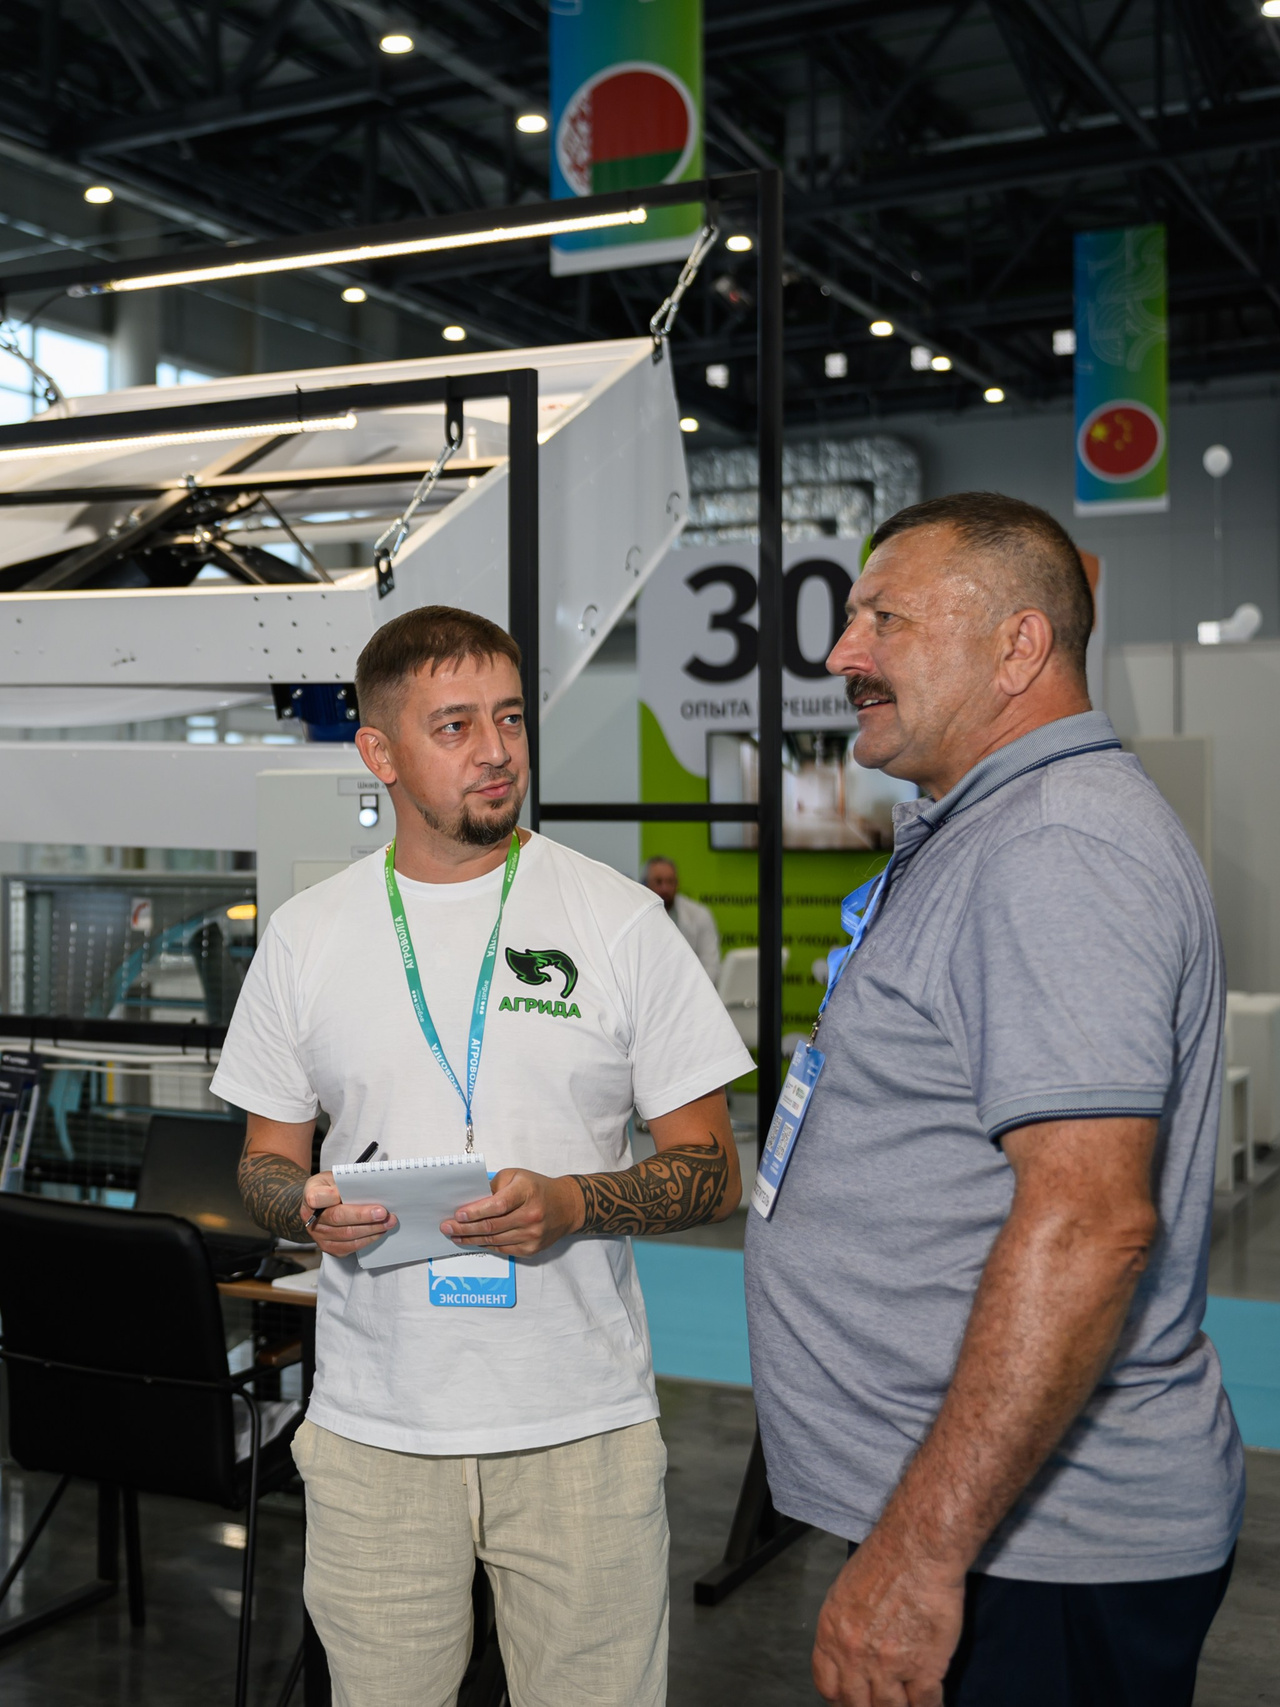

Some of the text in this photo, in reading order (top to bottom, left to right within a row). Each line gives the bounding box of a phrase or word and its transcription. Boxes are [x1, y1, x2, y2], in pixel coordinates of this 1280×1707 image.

[683, 557, 854, 685] 30
[680, 696, 858, 720] ОПЫТА ЕШЕН
[394, 915, 415, 969] АГРОВОЛГА
[499, 996, 582, 1018] АГРИДА
[439, 1293, 508, 1305] ЭКСПОНЕНТ
